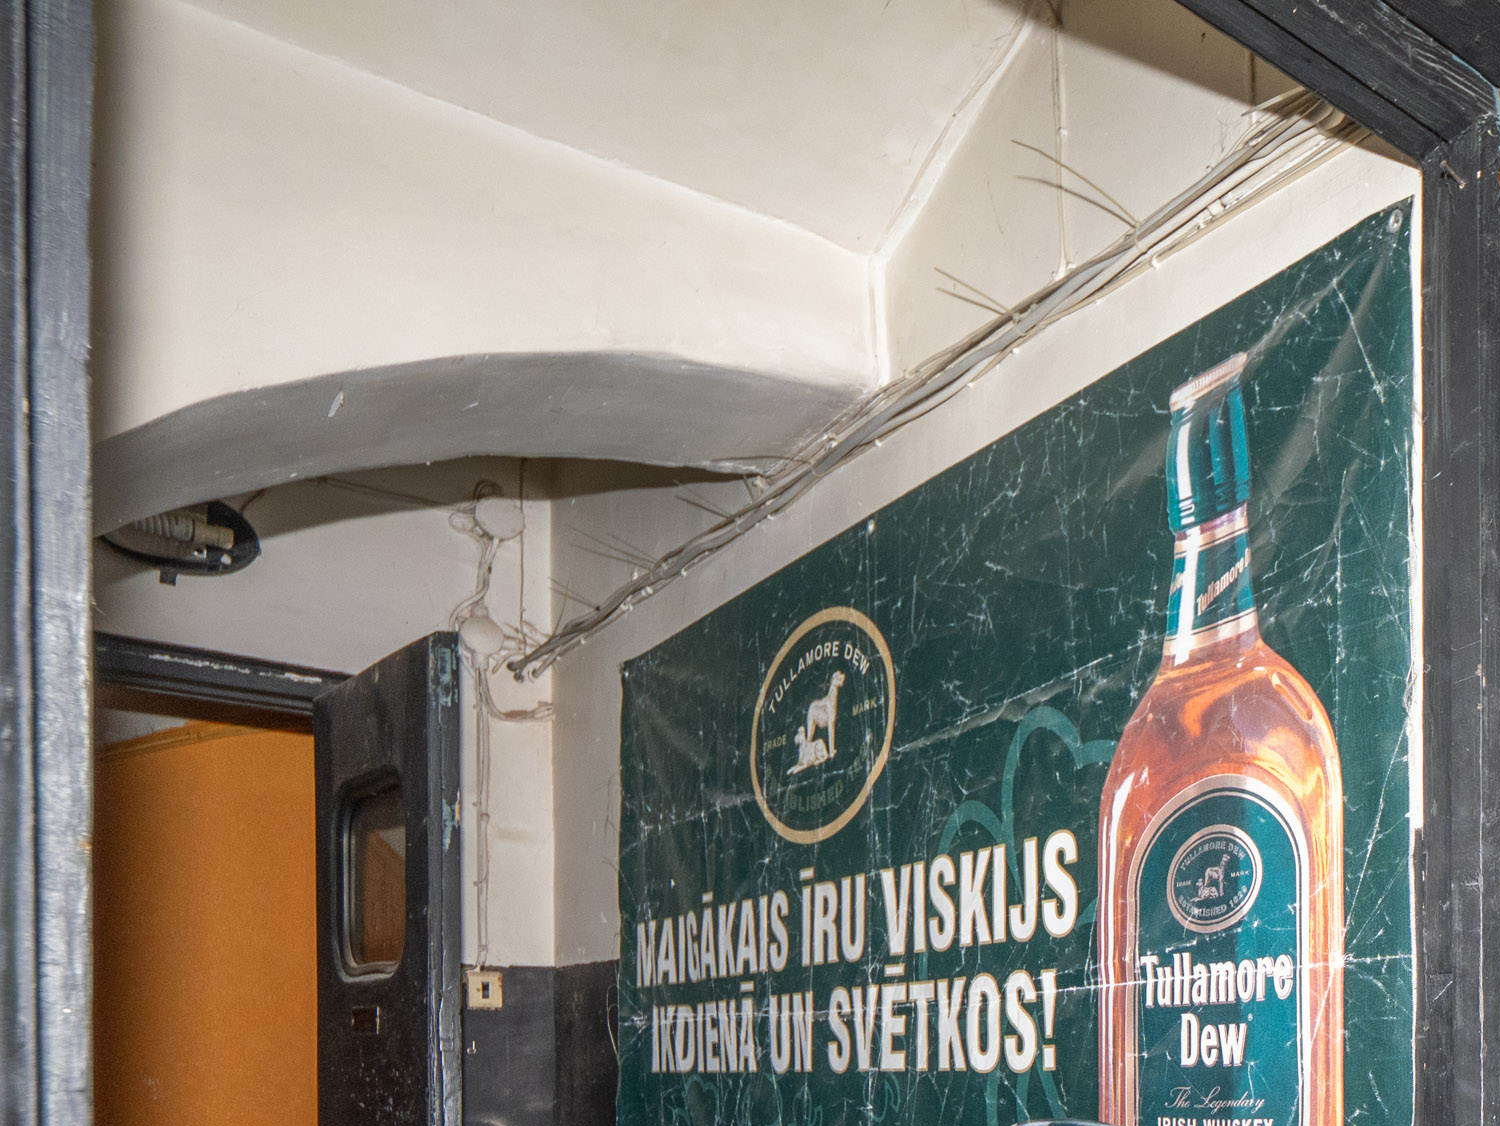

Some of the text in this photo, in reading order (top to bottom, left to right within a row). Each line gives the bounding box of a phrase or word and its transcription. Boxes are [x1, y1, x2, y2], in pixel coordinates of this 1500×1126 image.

[769, 641, 870, 714] TULLAMORE DEW
[763, 697, 877, 751] TRADE MARK
[1180, 841, 1247, 871] TULLAMORE DEW
[636, 829, 1079, 989] MAIGĀKAIS ĪRU VISKIJS
[1139, 952, 1294, 1009] Tullamore
[650, 962, 1057, 1074] IKDIENĀ UN SVĒTKOS!
[1180, 1013, 1248, 1068] Dew
[1165, 1086, 1265, 1115] The Legendary
